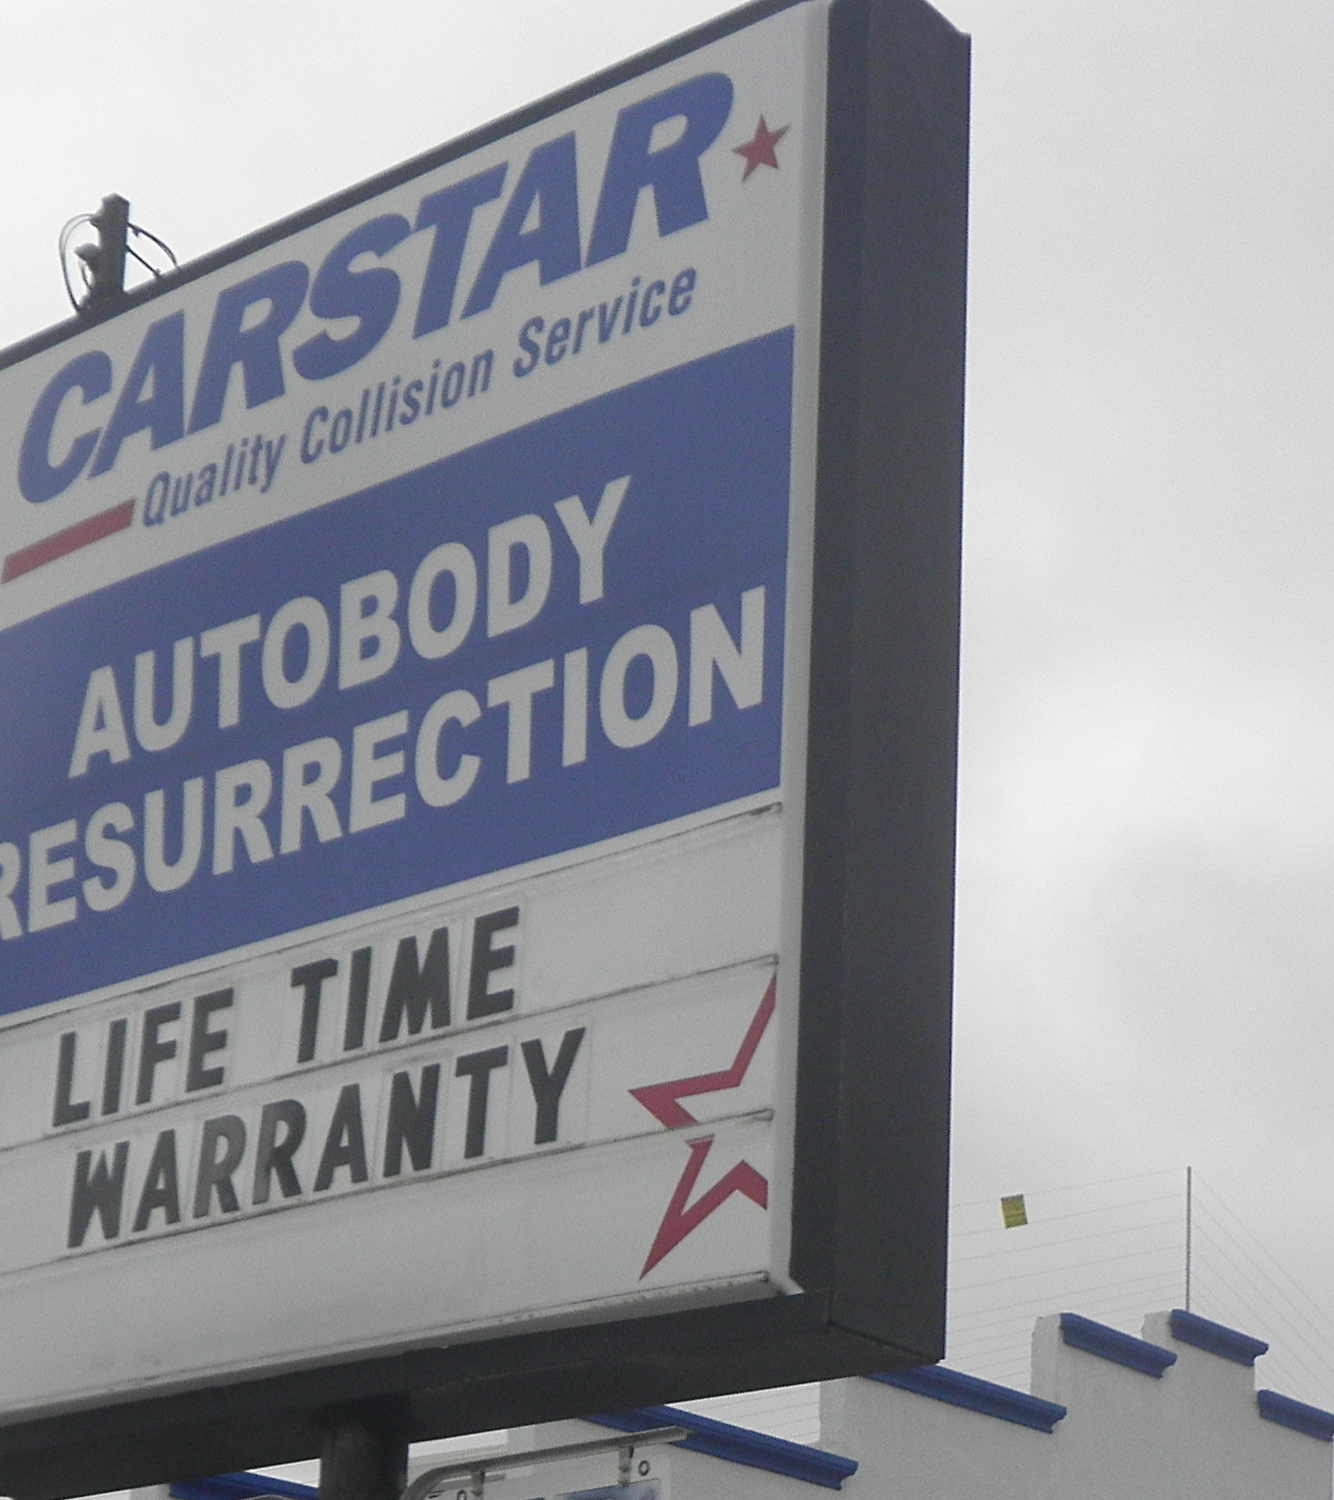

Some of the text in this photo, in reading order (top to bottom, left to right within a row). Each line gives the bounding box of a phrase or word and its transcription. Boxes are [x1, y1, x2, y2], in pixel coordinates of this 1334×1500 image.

[17, 72, 735, 504] CARSTAR
[141, 267, 698, 527] Quality Collision Service
[69, 475, 632, 779] AUTOBODY
[52, 906, 520, 1128] LIFE TIME
[67, 1027, 587, 1249] WARRANTY
